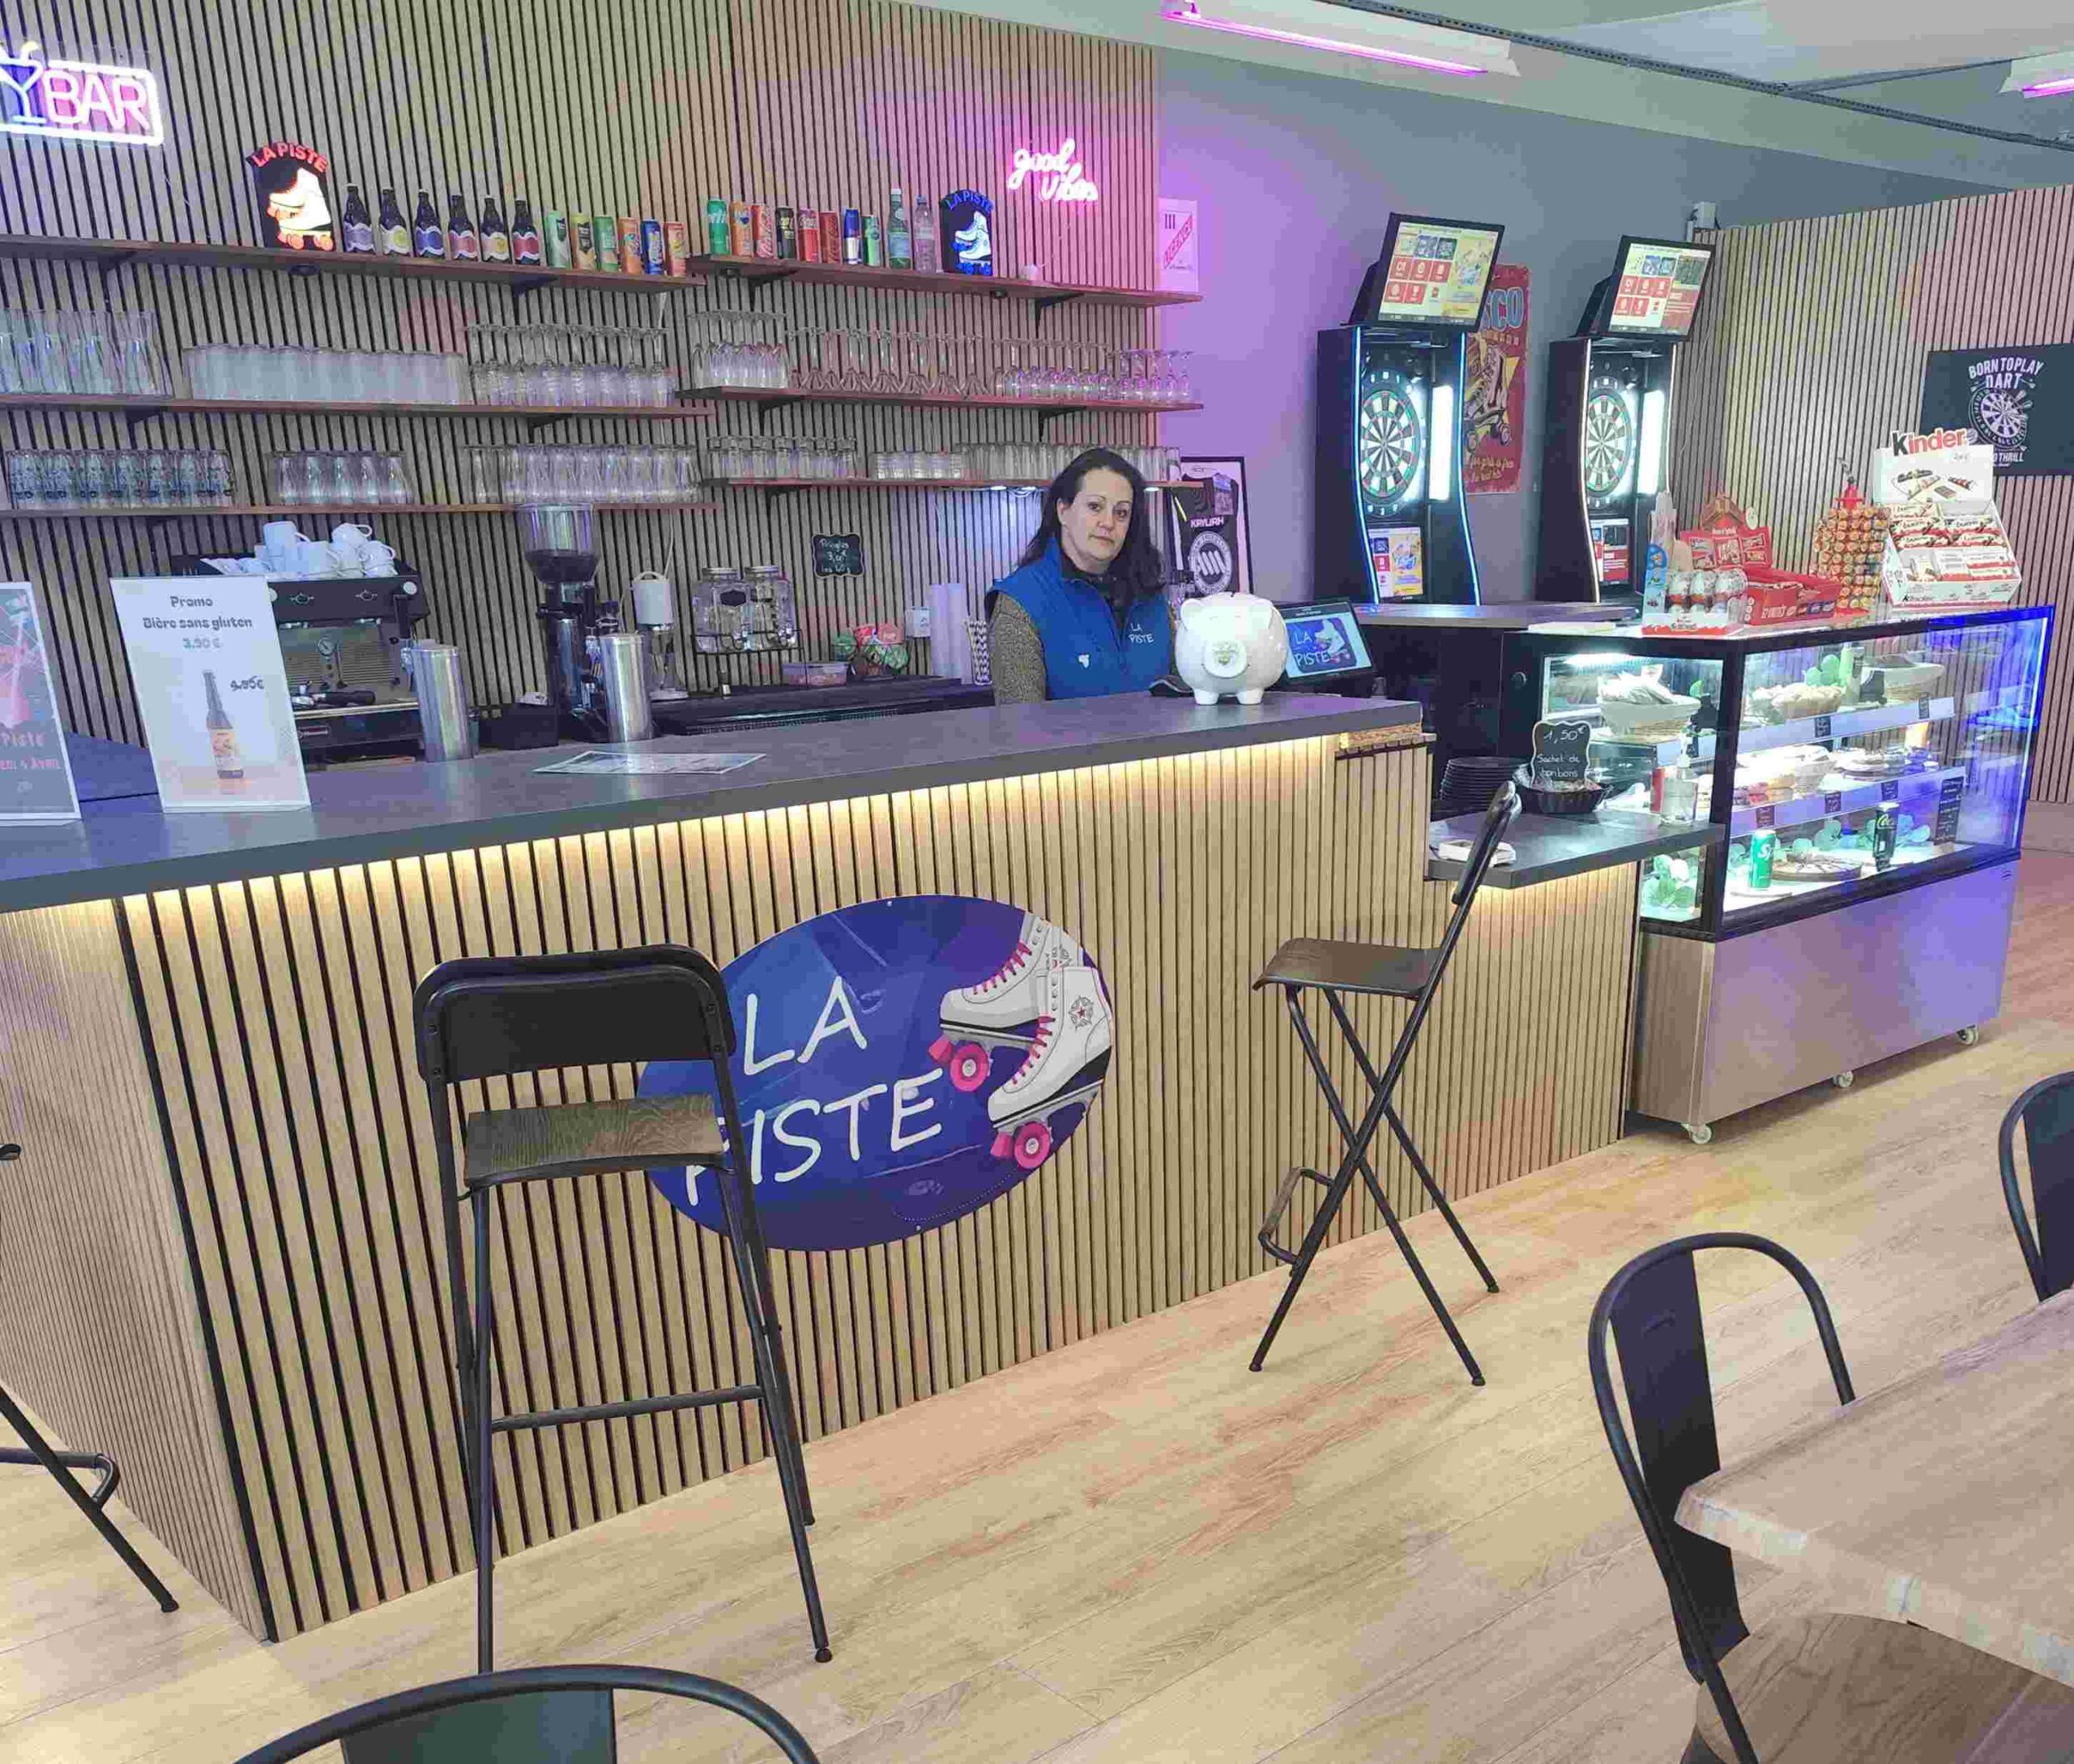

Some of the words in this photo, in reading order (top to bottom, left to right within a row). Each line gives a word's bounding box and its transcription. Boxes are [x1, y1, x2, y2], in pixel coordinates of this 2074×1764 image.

[41, 69, 151, 130] BAR
[251, 146, 277, 167] LA
[276, 142, 328, 173] PISTE
[945, 195, 962, 210] LA
[1968, 358, 1999, 379] BORN
[2000, 357, 2014, 372] TO
[2014, 357, 2044, 376] PLAY
[1985, 372, 2023, 389] DART
[1892, 428, 1966, 457] Kinder
[169, 596, 214, 608] Promo
[142, 617, 177, 629] Bière
[179, 619, 210, 629] sans
[211, 616, 253, 631] gluten
[1130, 622, 1143, 632] LA
[1129, 634, 1154, 644] PISTE
[1295, 631, 1313, 645] LA
[1294, 651, 1331, 667] PISTE
[1536, 753, 1564, 763] Sachet
[1568, 754, 1581, 763] de
[1541, 767, 1579, 778] bonbons
[743, 976, 867, 1076] LA
